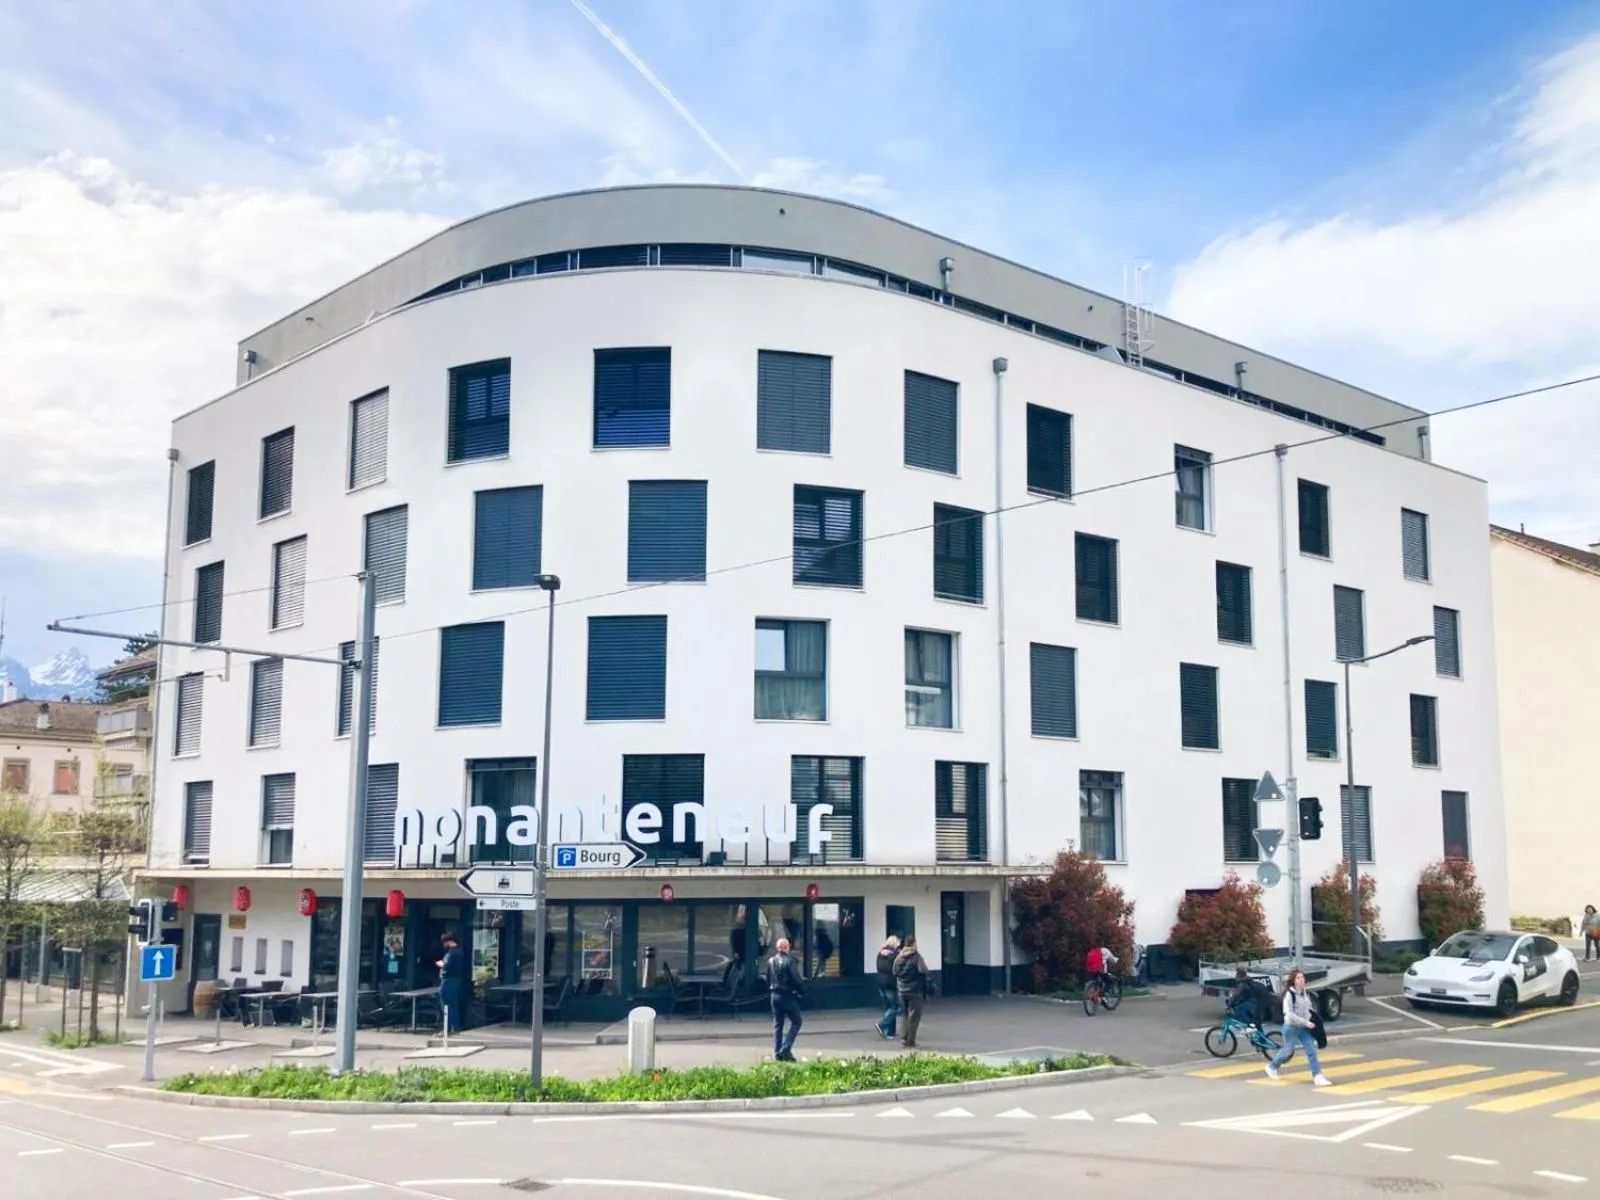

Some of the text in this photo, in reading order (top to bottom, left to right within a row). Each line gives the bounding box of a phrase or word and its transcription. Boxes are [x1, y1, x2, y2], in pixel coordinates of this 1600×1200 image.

[394, 792, 834, 854] nonanteneuf
[580, 849, 621, 866] Bourg
[501, 900, 520, 908] Poste
